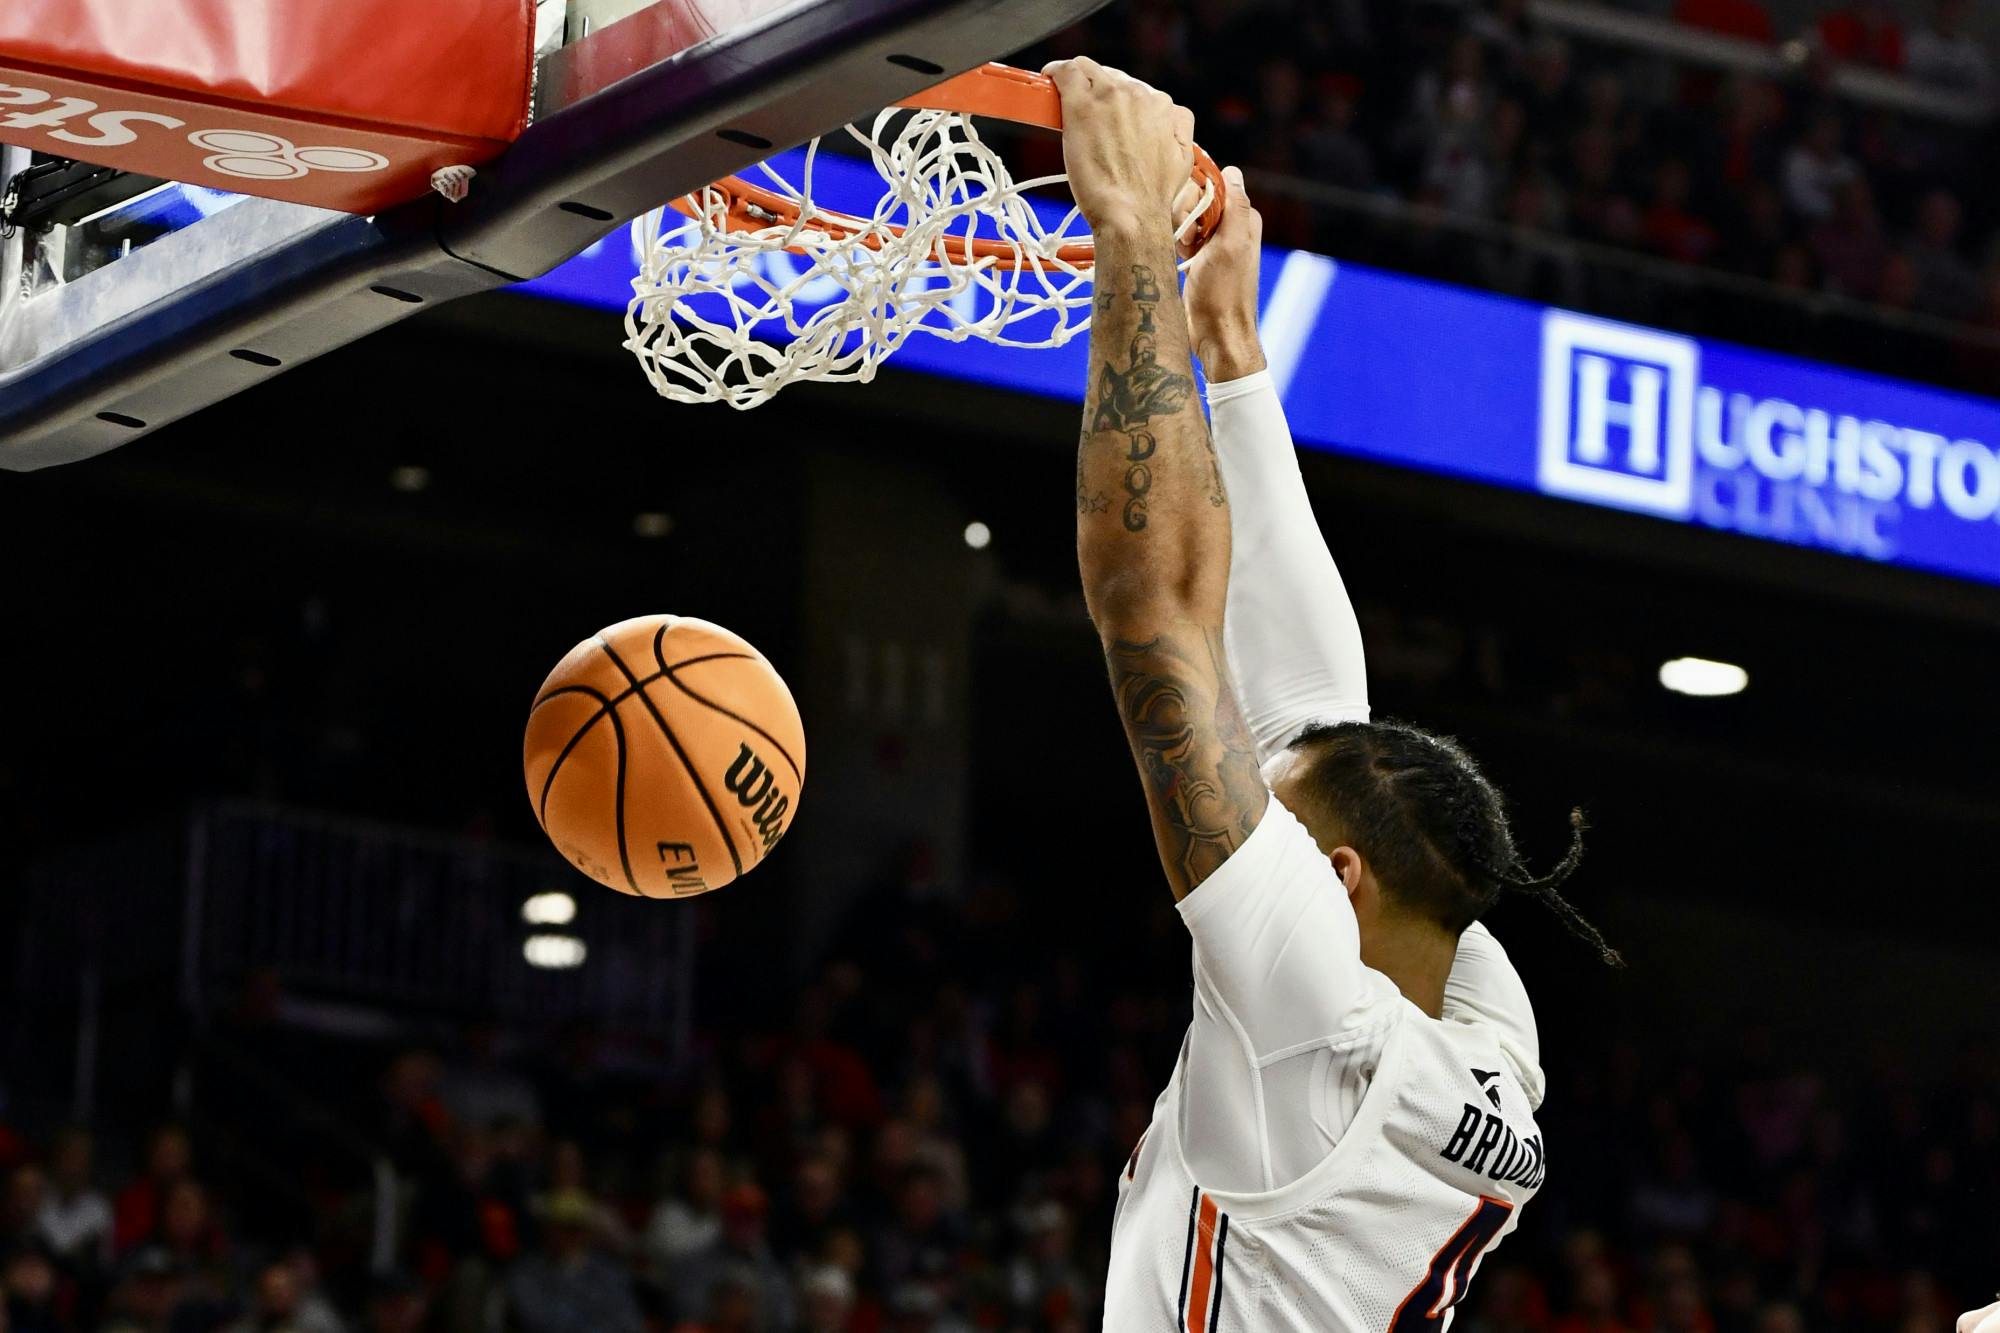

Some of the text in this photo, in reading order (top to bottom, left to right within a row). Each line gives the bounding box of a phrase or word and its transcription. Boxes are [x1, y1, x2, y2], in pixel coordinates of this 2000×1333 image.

[1123, 264, 1161, 532] BIG DOG
[1576, 352, 2000, 522] HUGHSTO
